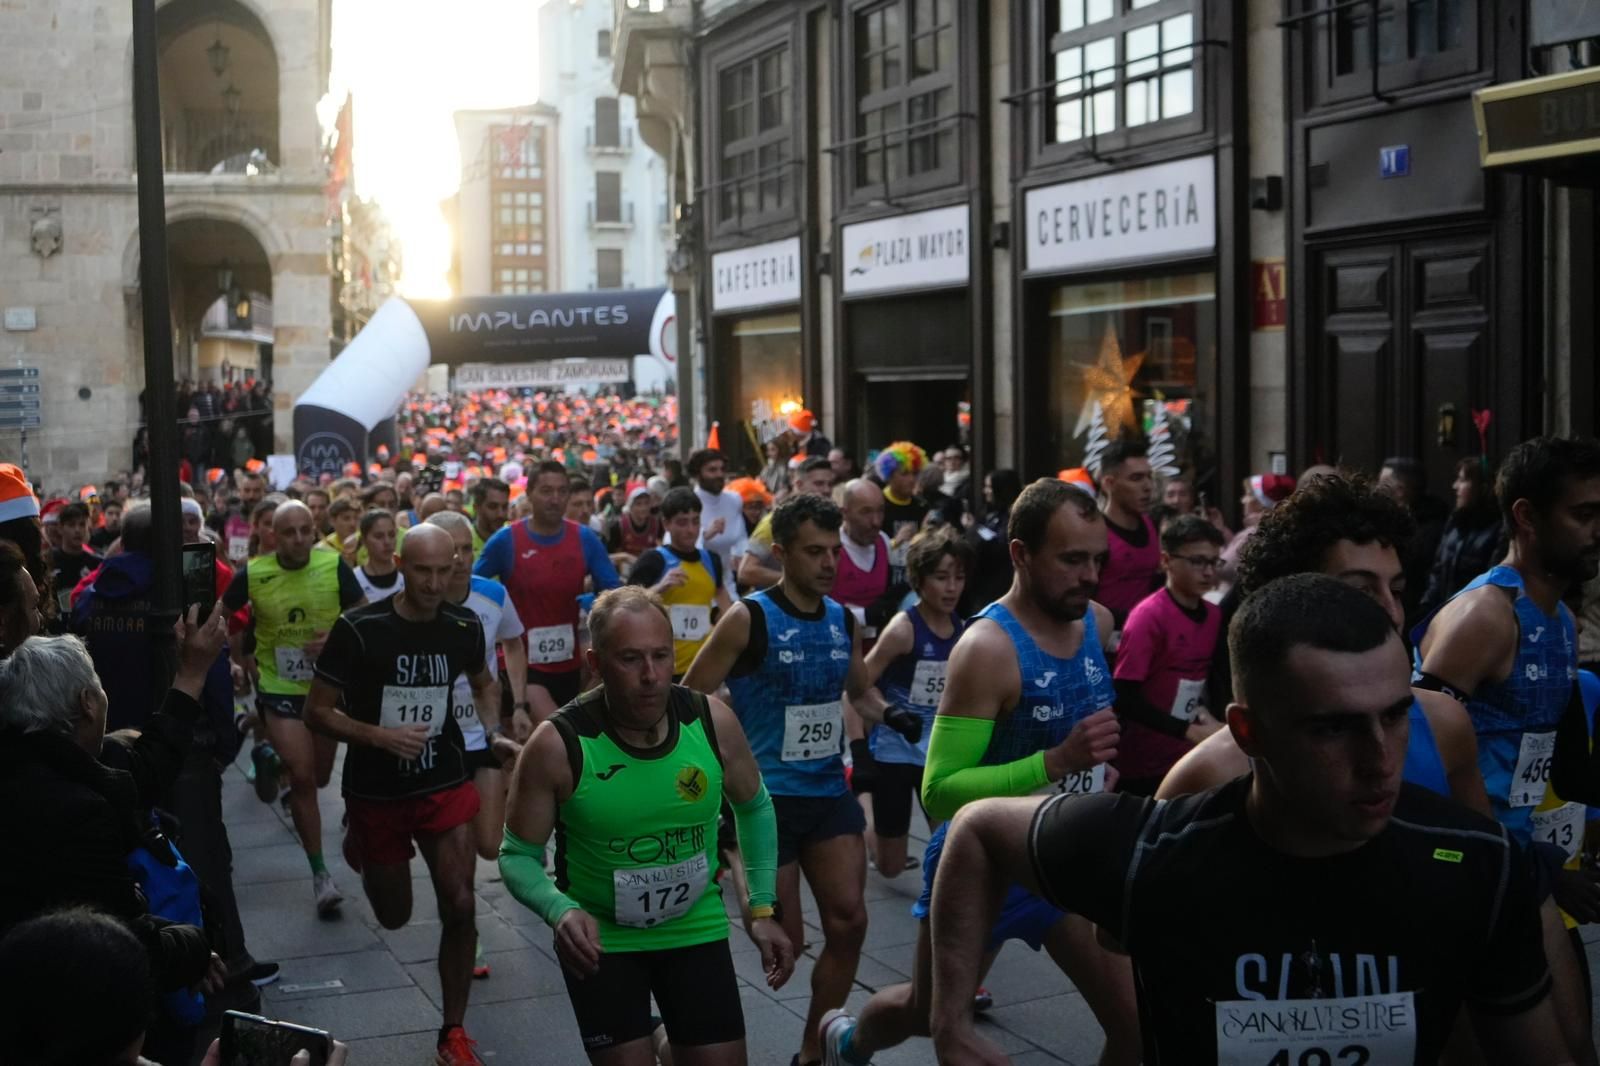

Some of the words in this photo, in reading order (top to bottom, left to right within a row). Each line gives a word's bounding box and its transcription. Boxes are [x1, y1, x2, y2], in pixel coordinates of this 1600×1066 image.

[875, 238, 912, 266] PLAZA
[918, 229, 964, 258] MAYOR
[449, 304, 629, 333] IMPLANTES
[683, 617, 698, 630] 10
[538, 638, 565, 653] 629
[925, 677, 945, 693] 55
[397, 705, 432, 722] 118
[798, 721, 832, 743] 259
[1521, 758, 1553, 783] 456
[638, 882, 690, 913] 172
